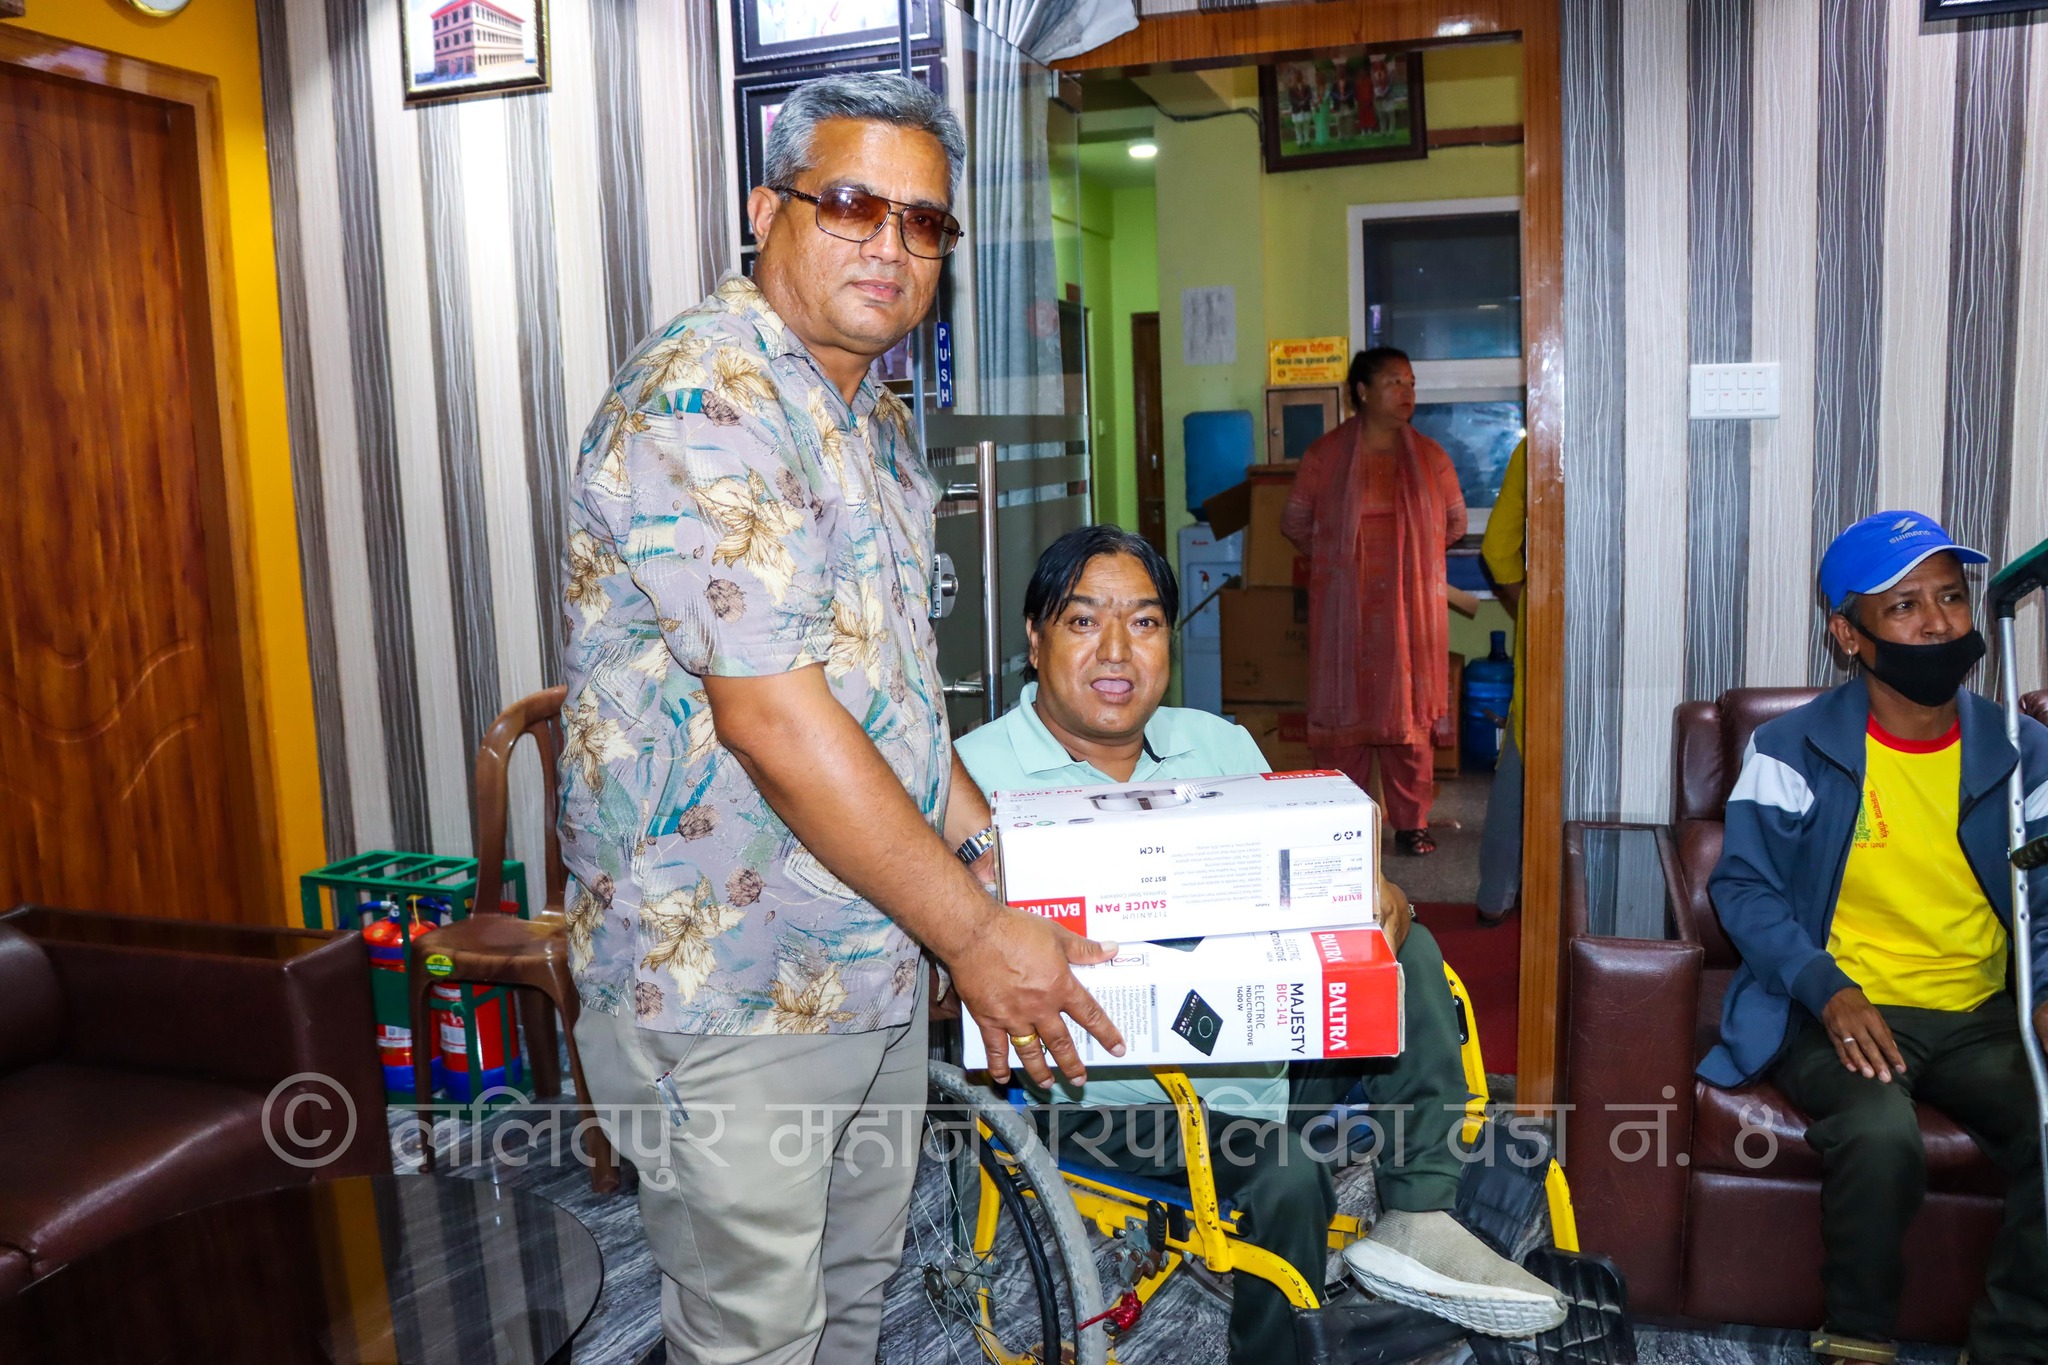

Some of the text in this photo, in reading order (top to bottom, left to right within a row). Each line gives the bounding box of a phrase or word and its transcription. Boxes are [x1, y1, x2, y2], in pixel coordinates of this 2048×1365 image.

[939, 328, 949, 402] PUSH
[1139, 846, 1153, 855] CM
[1156, 846, 1165, 854] 14
[1095, 900, 1166, 913] SAUCE PAN
[1332, 894, 1362, 902] BALTRA
[1122, 911, 1166, 920] TITANIUM
[1318, 933, 1343, 962] BALTRA
[1254, 985, 1265, 1029] ELECTRIC
[1276, 984, 1287, 1026] BIC-141
[1290, 983, 1305, 1054] MAJESTY
[1329, 982, 1346, 1051] BALTRA
